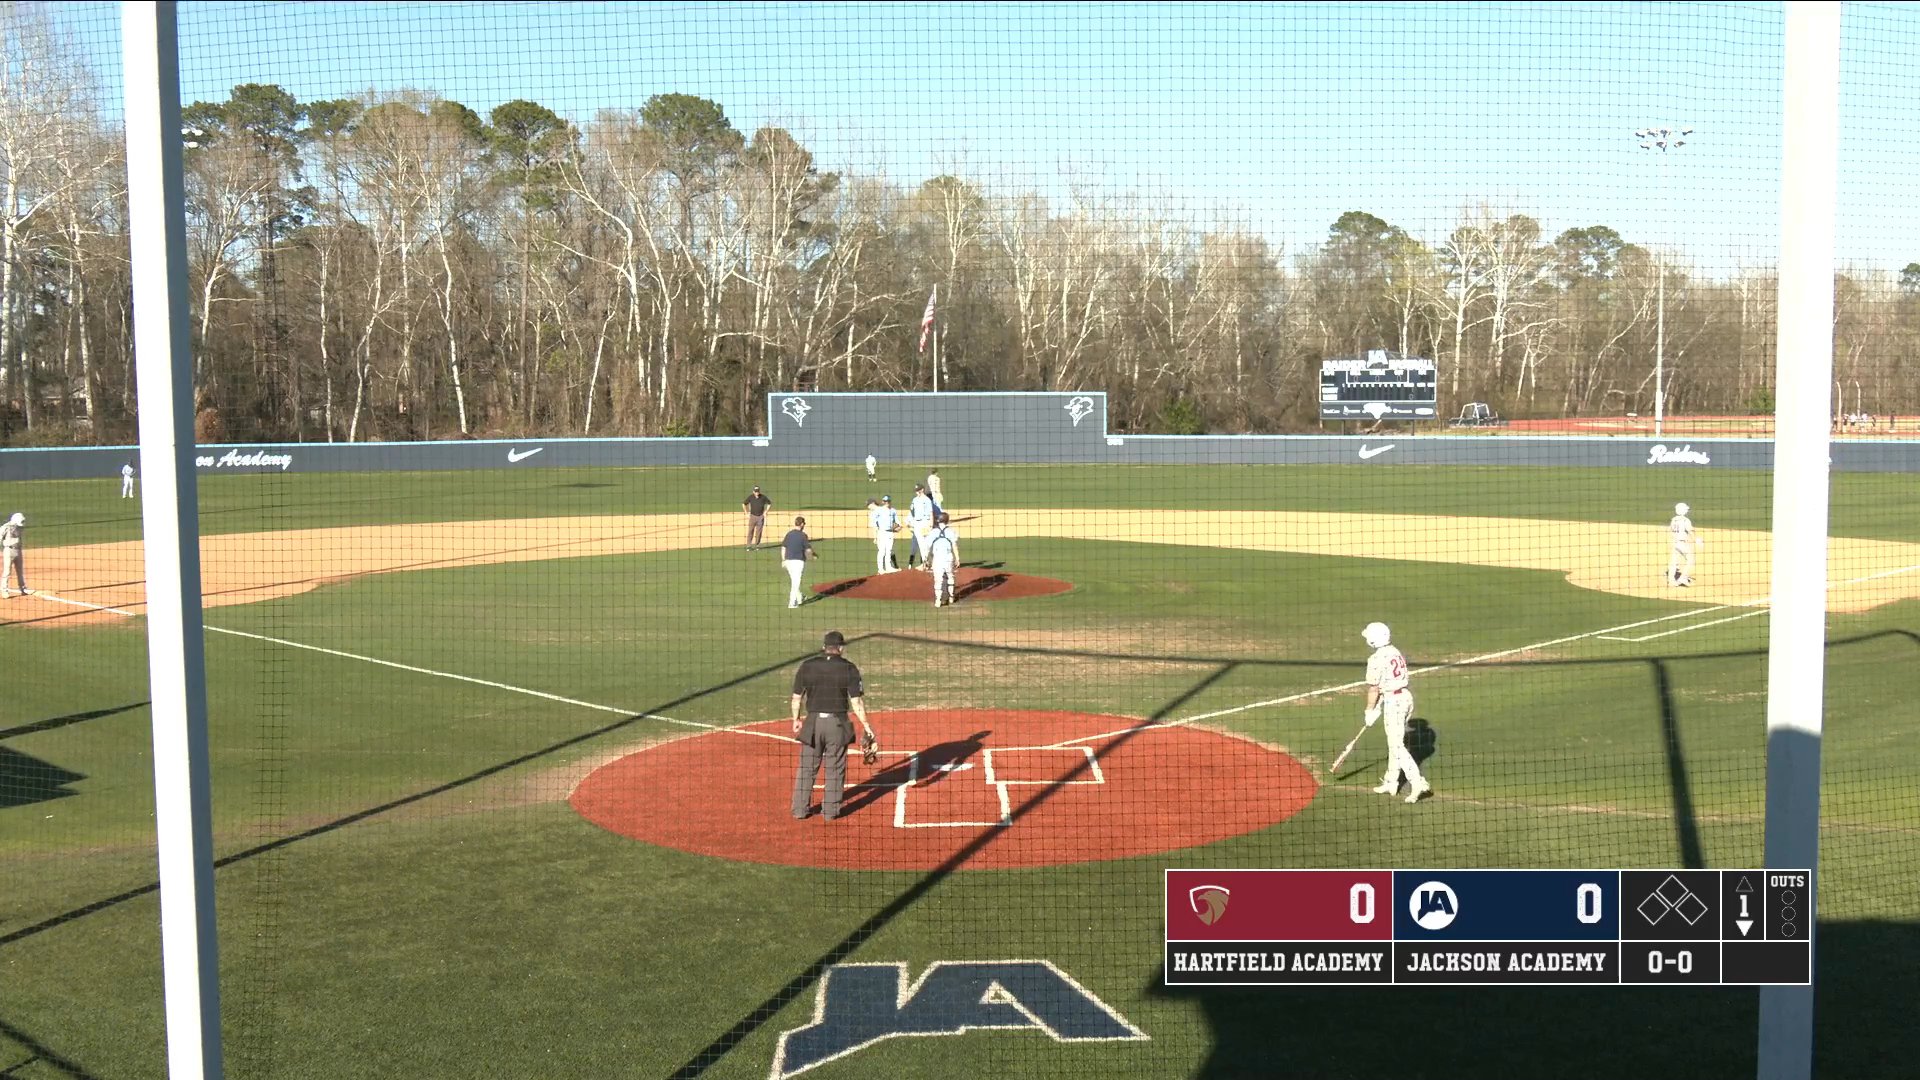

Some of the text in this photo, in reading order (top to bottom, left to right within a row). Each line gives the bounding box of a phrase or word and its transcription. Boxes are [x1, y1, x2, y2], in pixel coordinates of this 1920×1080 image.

[217, 449, 292, 470] Academy
[1647, 444, 1711, 465] Raiders
[768, 958, 1151, 1080] JA
